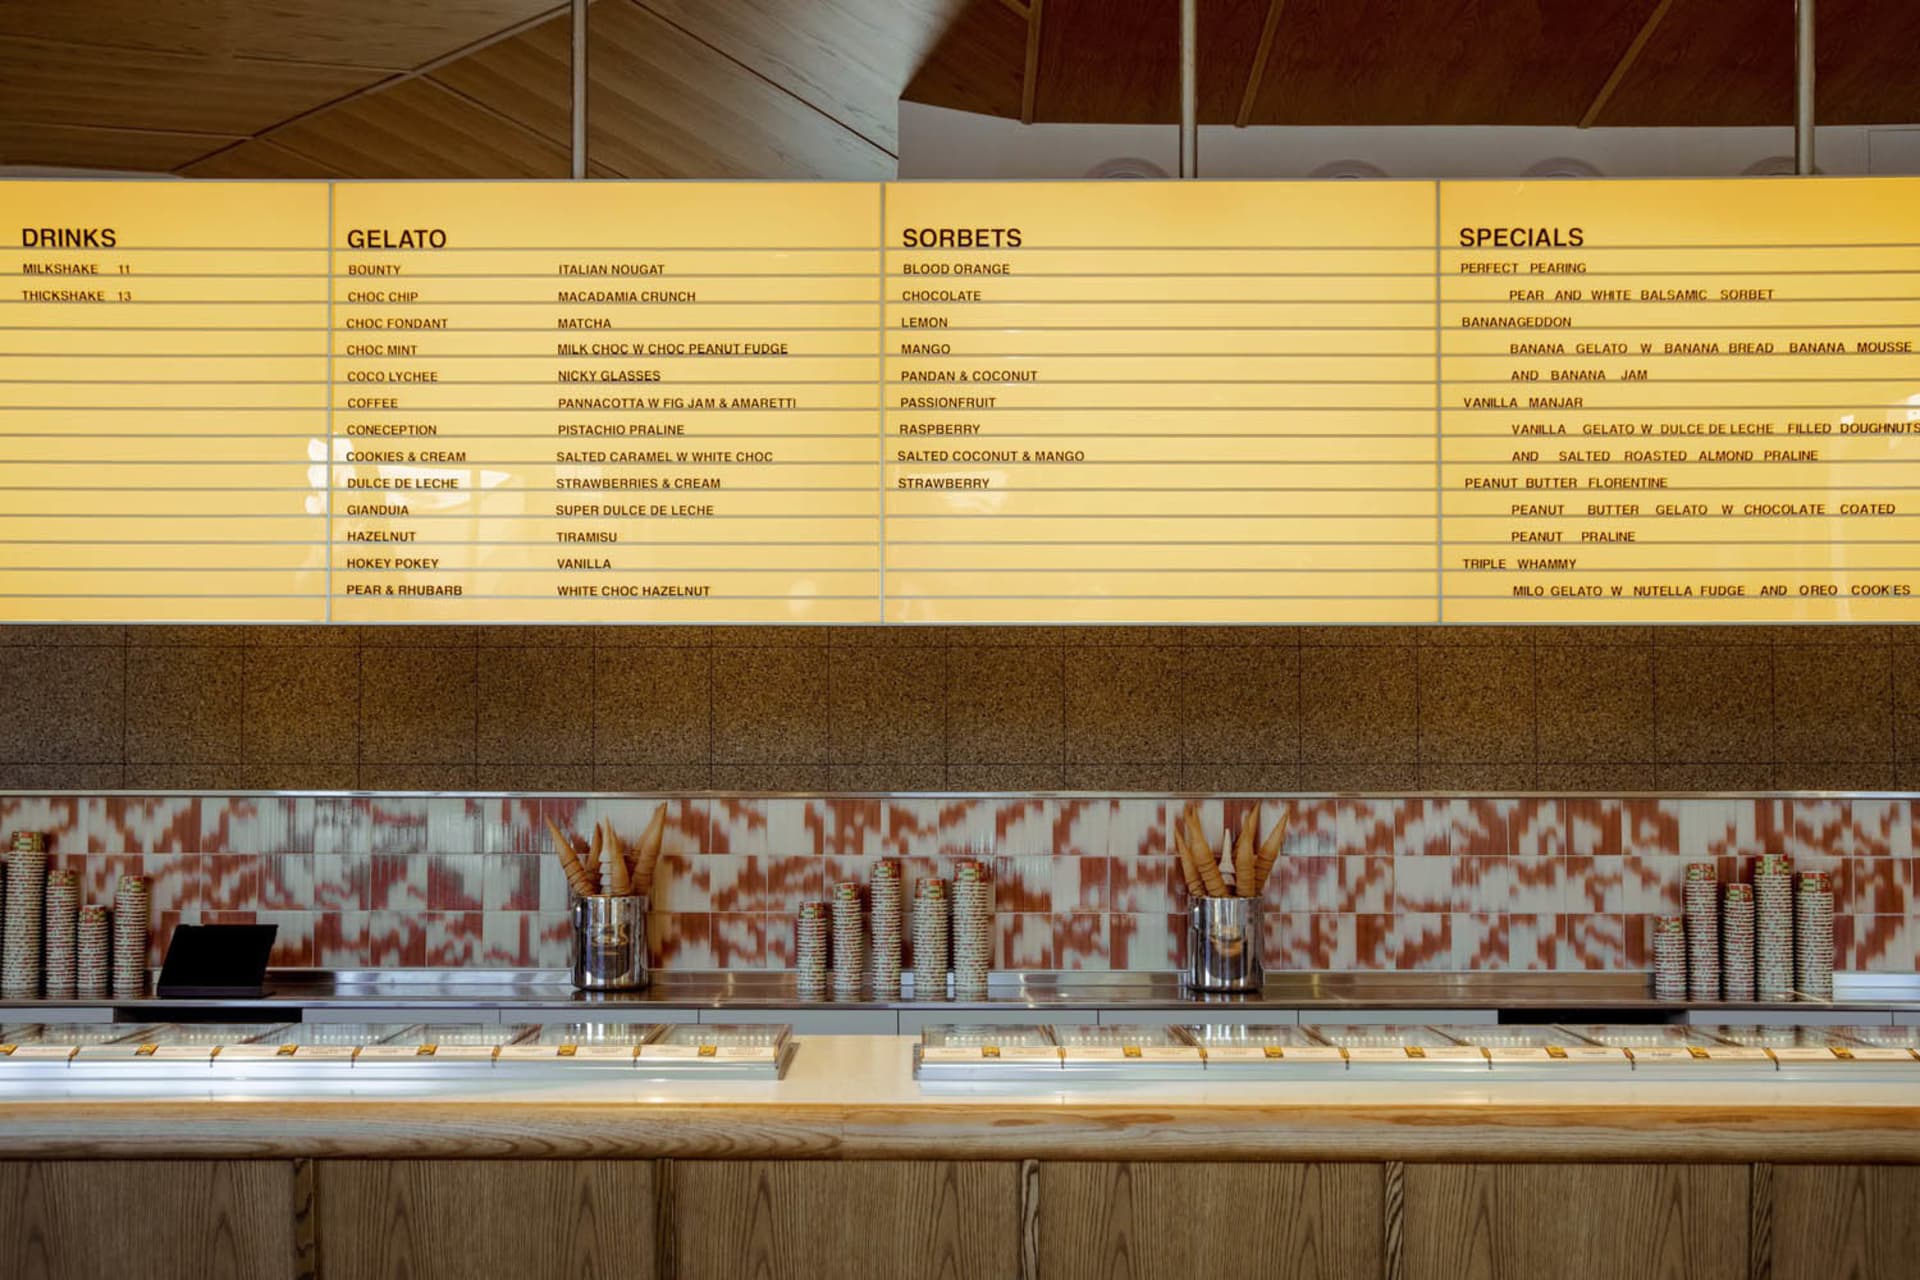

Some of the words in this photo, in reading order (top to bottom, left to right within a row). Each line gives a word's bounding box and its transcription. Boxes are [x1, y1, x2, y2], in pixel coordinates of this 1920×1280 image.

[21, 228, 117, 248] DRINKS
[346, 229, 447, 249] GELATO
[902, 228, 1023, 248] SORBETS
[1459, 228, 1584, 248] SPECIALS
[22, 263, 99, 275] MILKSHAKE
[117, 264, 131, 276] 11
[348, 264, 401, 276] BOUNTY
[558, 264, 608, 276] ITALIAN
[611, 264, 665, 276] NOUGAT
[903, 263, 950, 275] BLOOD
[953, 263, 1010, 275] ORANGE
[1460, 262, 1519, 274] PERFECT
[1530, 262, 1587, 274] PEARING
[21, 290, 105, 302] THICKSHAKE
[117, 291, 132, 303] 13
[347, 291, 385, 303] CHOC
[388, 291, 419, 303] CHIP
[557, 291, 637, 303] MACADAMIA
[640, 291, 696, 303] CRUNCH
[901, 290, 981, 302] CHOCOLATE
[1509, 290, 1545, 302] PEAR
[1554, 289, 1582, 301] AND
[1590, 289, 1631, 301] WHITE
[1640, 289, 1707, 301] BALSAMIC
[1720, 288, 1773, 300] SORBET
[345, 318, 383, 330] CHOC
[387, 318, 448, 330] FONDANT
[557, 317, 611, 329] MATCHA
[901, 316, 948, 328] LEMON
[1461, 316, 1572, 328] BANANAGEDDON
[346, 344, 384, 356] CHOC
[387, 344, 418, 356] MINT
[557, 343, 588, 355] MILK
[591, 343, 629, 355] CHOC
[632, 343, 646, 355] W
[647, 343, 685, 355] CHOC
[688, 343, 741, 355] PEANUT
[744, 343, 789, 355] FUDGE
[901, 343, 951, 355] MANGO
[1509, 343, 1565, 355] BANANA
[1575, 343, 1628, 355] GELATO
[1640, 343, 1653, 355] W
[1664, 343, 1719, 355] BANANA
[1728, 342, 1774, 354] BREAD
[1789, 342, 1845, 354] BANANA
[1856, 341, 1912, 353] MOUSSE
[347, 371, 385, 383] COCO
[388, 371, 438, 383] LYCHEE
[557, 369, 598, 381] NICKY
[599, 369, 662, 381] GLASSES
[900, 370, 956, 382] PANDAN
[959, 370, 969, 382] &
[972, 370, 1038, 382] COCONUT
[1511, 370, 1540, 382] AND
[1550, 369, 1606, 381] BANANA
[1620, 369, 1648, 381] JAM
[347, 397, 398, 409] COFFEE
[558, 397, 645, 409] PANNACOTTA
[647, 397, 660, 409] W
[663, 397, 685, 409] FIG
[687, 397, 717, 409] JAM
[719, 397, 728, 409] &
[730, 397, 797, 409] AMARETTI
[900, 396, 997, 408] PASSIONFRUIT
[1463, 397, 1518, 409] VANILLA
[1528, 396, 1583, 408] MANJAR
[346, 424, 437, 436] CONECEPTION
[557, 424, 627, 436] PISTACHIO
[628, 424, 684, 436] PRALINE
[899, 423, 981, 435] RASPBERRY
[1511, 424, 1566, 436] VANILLA
[1582, 423, 1635, 435] GELATO
[1640, 423, 1653, 435] W
[1659, 423, 1704, 435] DULCE
[1708, 423, 1726, 435] DE
[1729, 423, 1774, 435] LECHE
[1787, 423, 1832, 435] FILLED
[1839, 422, 1920, 434] DOUGHNUTS
[345, 451, 404, 463] COOKIES
[407, 451, 417, 463] &
[419, 451, 467, 463] CREAM
[556, 451, 607, 463] SALTED
[608, 451, 673, 463] CARAMEL
[676, 451, 689, 463] W
[691, 451, 732, 463] WHITE
[735, 451, 773, 463] CHOC
[897, 450, 949, 462] SALTED
[951, 450, 1019, 462] COCONUT
[1021, 450, 1032, 462] &
[1034, 450, 1085, 462] MANGO
[1512, 451, 1540, 463] AND
[1559, 450, 1611, 462] SALTED
[1624, 450, 1688, 462] ROASTED
[1699, 449, 1754, 461] ALMOND
[1763, 449, 1818, 461] PRALINE
[347, 477, 390, 489] DULCE
[394, 477, 412, 489] DE
[414, 477, 460, 489] LECHE
[555, 478, 659, 490] STRAWBERRIES
[661, 478, 671, 490] &
[673, 477, 721, 489] CREAM
[898, 477, 990, 489] STRAWBERRY
[1464, 477, 1518, 489] PEANUT
[1525, 476, 1578, 488] BUTTER
[1588, 477, 1667, 489] FLORENTINE
[346, 504, 409, 516] GIANDUIA
[555, 504, 600, 516] SUPER
[602, 504, 646, 516] DULCE
[649, 505, 667, 517] DE
[671, 504, 714, 516] LECHE
[1511, 504, 1565, 516] PEANUT
[1587, 504, 1640, 516] BUTTER
[1655, 504, 1708, 516] GELATO
[1721, 503, 1734, 515] W
[1743, 503, 1825, 515] CHOCOLATE
[1839, 503, 1896, 515] COATED
[347, 530, 417, 542] HAZELNUT
[555, 531, 618, 543] TIRAMISU
[1511, 531, 1563, 543] PEANUT
[1581, 531, 1636, 543] PRALINE
[346, 558, 392, 570] HOKEY
[394, 557, 439, 569] POKEY
[556, 558, 611, 570] VANILLA
[1463, 558, 1506, 570] TRIPLE
[1516, 558, 1577, 570] WHAMMY
[346, 584, 382, 596] PEAR
[385, 584, 394, 596] &
[398, 584, 463, 596] RHUBARB
[556, 585, 599, 597] WHITE
[600, 585, 639, 597] CHOC
[642, 585, 711, 597] HAZELNUT
[1512, 584, 1545, 596] MILO
[1549, 585, 1603, 597] GELATO
[1610, 585, 1623, 597] W
[1632, 585, 1693, 597] NUTELLA
[1700, 584, 1745, 596] FUDGE
[1760, 584, 1788, 596] AND
[1798, 584, 1838, 596] OREO
[1850, 584, 1911, 596] COOKES
